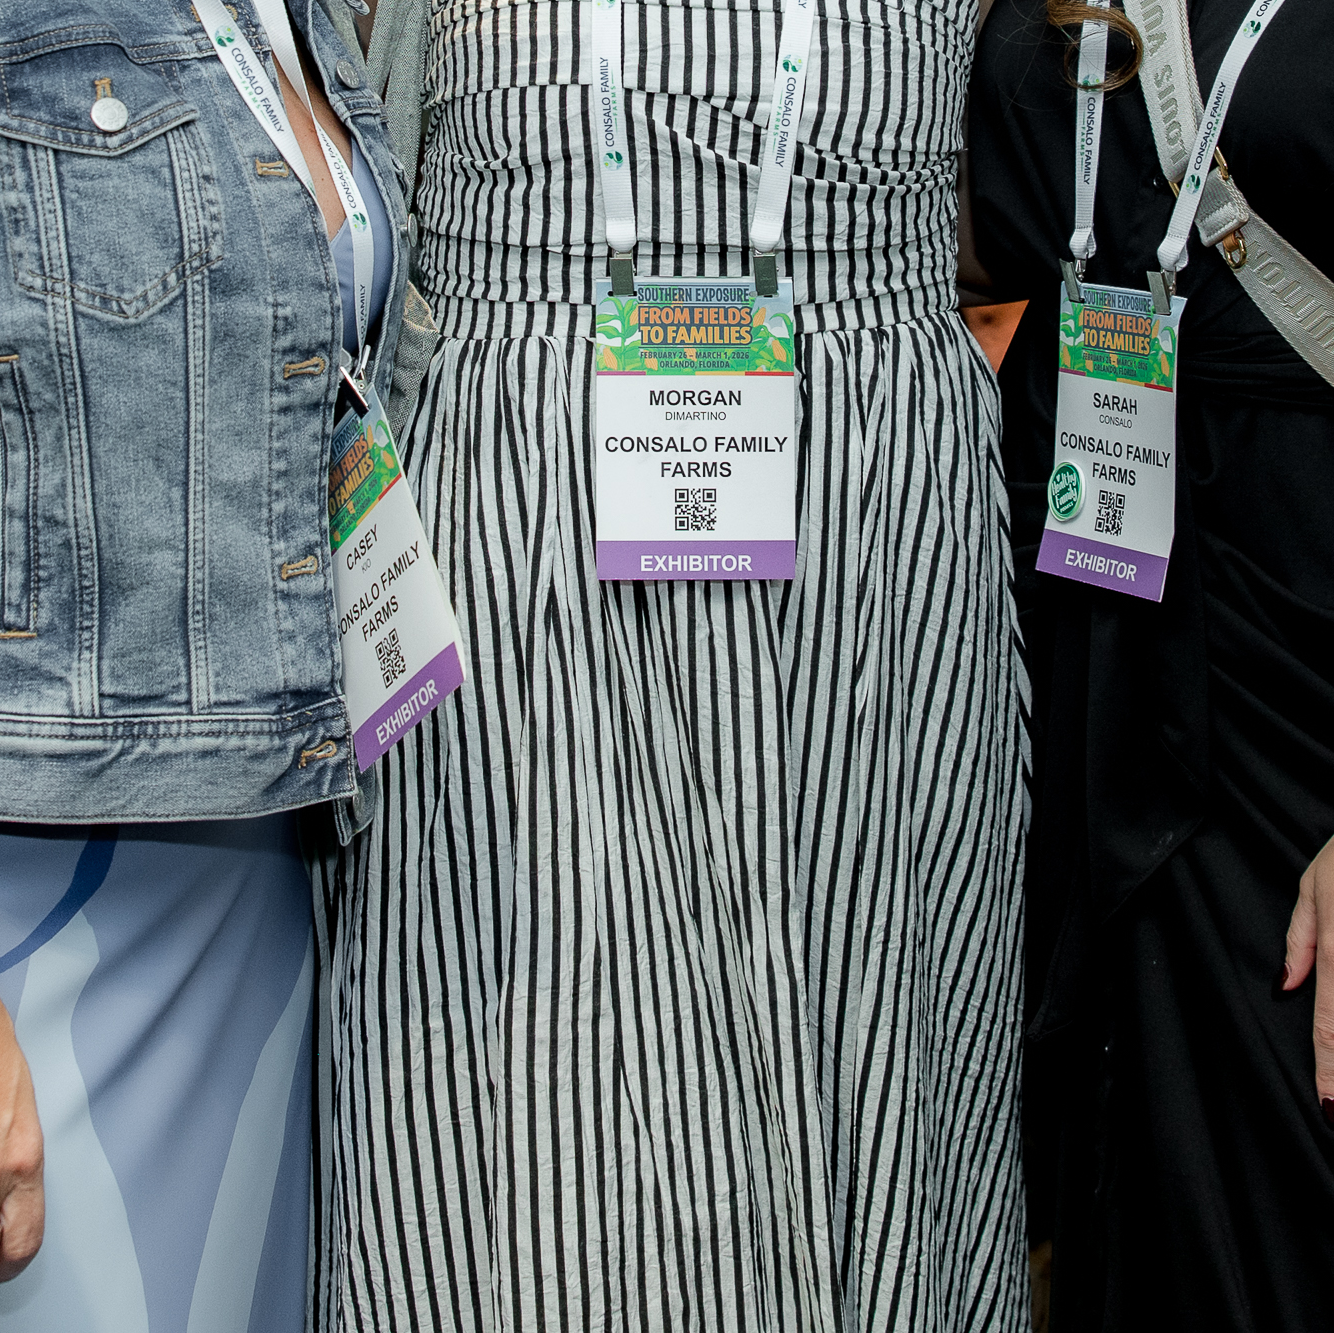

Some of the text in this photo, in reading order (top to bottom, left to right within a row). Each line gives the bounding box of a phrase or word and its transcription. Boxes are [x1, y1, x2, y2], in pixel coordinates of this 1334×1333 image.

[231, 47, 285, 133] CONSALO FAMILY
[240, 81, 261, 109] FARMS
[599, 57, 615, 148] CONSALO FAMILY
[773, 106, 782, 137] FARMS
[775, 77, 797, 168] CONSALO FAMILY
[1193, 81, 1227, 171] CONSALO FAMILY
[1083, 97, 1096, 185] CONSALO FAMILY
[333, 161, 357, 209] CONSALO
[638, 287, 749, 302] SOUTHERN EXPOSURE
[1083, 290, 1152, 313] SOUTHERN EXPOSURE
[639, 308, 752, 325] FROM FIELDS
[1084, 310, 1151, 335] FROM FIELDS
[640, 326, 752, 344] TO FAMILIES
[1083, 328, 1150, 355] TO FAMILIES
[640, 351, 677, 359] FEBRUARY
[678, 351, 687, 359] 26
[695, 351, 722, 359] MARCH
[723, 352, 730, 361] 1,
[732, 351, 750, 359] 2026
[659, 361, 730, 370] ORLANDO, FLORIDA
[649, 390, 742, 406] MORGAN
[1093, 393, 1138, 415] SARAH
[665, 412, 727, 421] DIMARTINO
[1099, 414, 1133, 429] CONSALO
[341, 433, 369, 477] FIELDS
[605, 437, 788, 453] CONSALO FAMILY
[1060, 431, 1171, 468] CONSALO FAMILY
[335, 453, 375, 508] FAMILIES
[661, 462, 732, 478] FARMS
[1092, 462, 1136, 486] FARMS
[346, 524, 379, 571] CASEY
[640, 555, 753, 572] EXHIBITOR
[1065, 548, 1137, 582] EXHIBITOR
[338, 583, 380, 642] ONSALO
[380, 541, 421, 592] FAMILY
[362, 595, 400, 642] FARMS
[375, 679, 439, 746] EXHIBITOR
